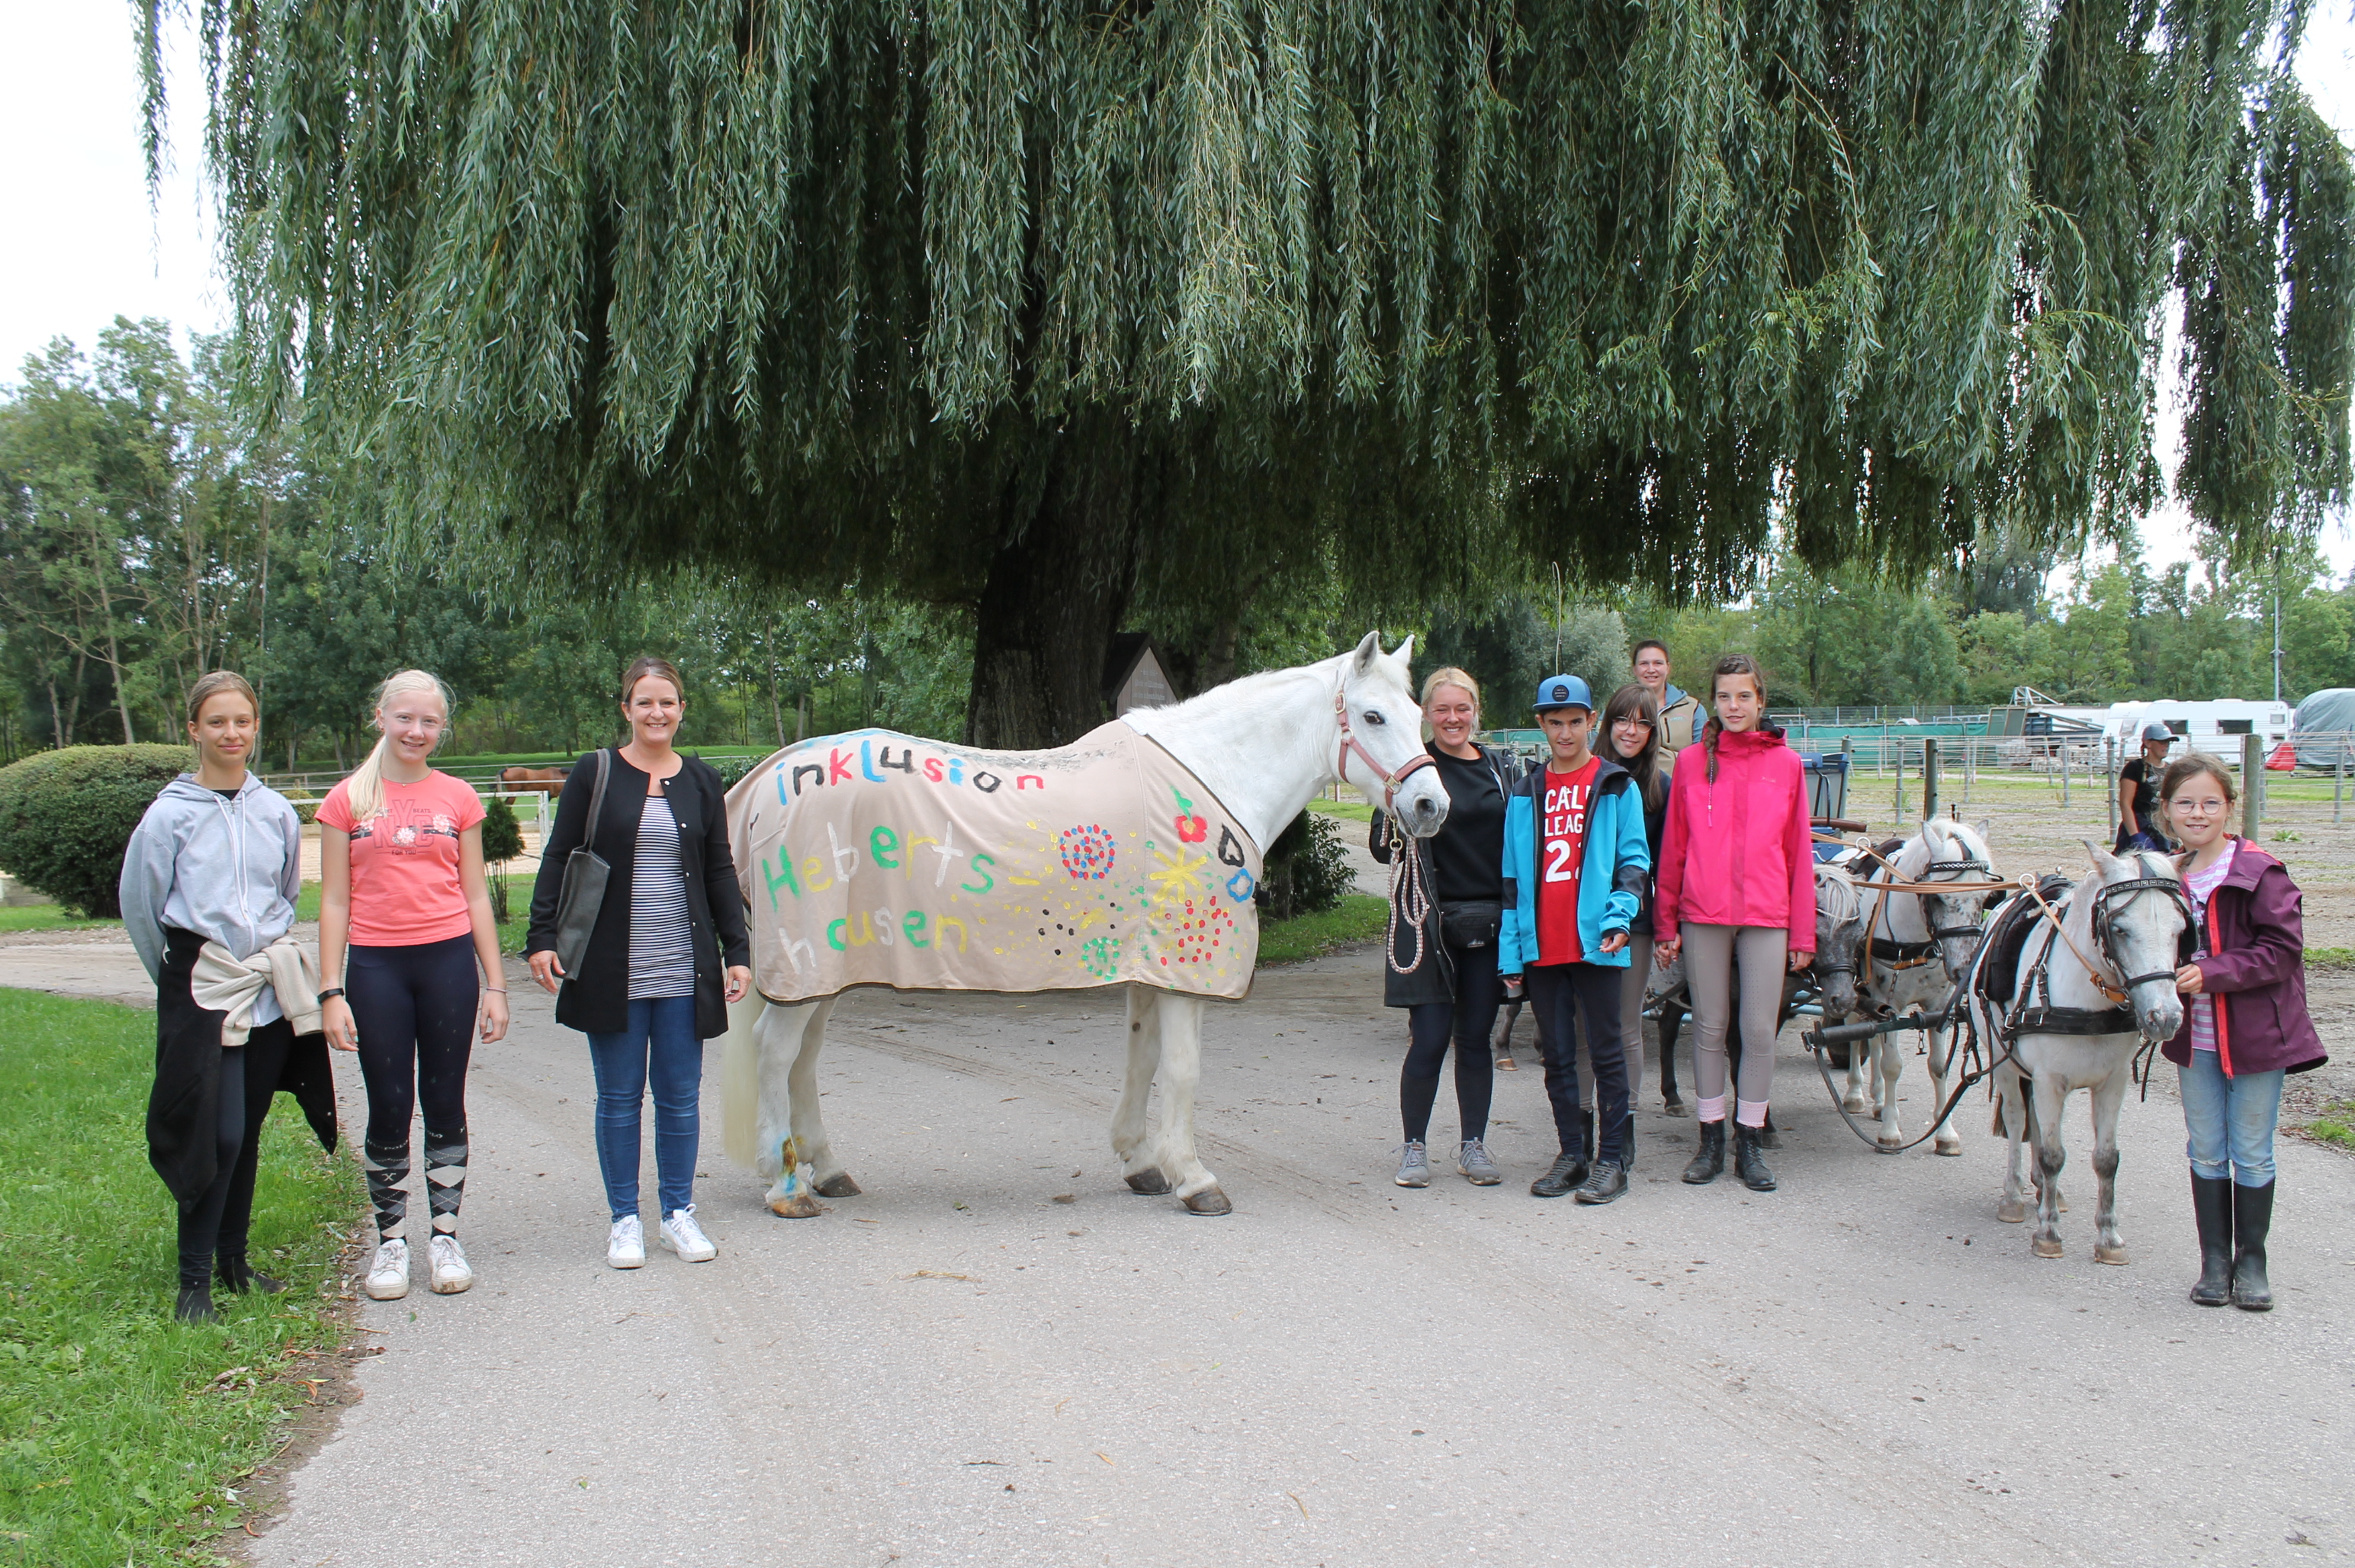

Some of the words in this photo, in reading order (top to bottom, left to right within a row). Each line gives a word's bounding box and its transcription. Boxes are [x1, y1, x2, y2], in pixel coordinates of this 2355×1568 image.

[373, 798, 435, 848] NYC
[763, 821, 994, 913] Heberts
[1545, 839, 1582, 882] 2
